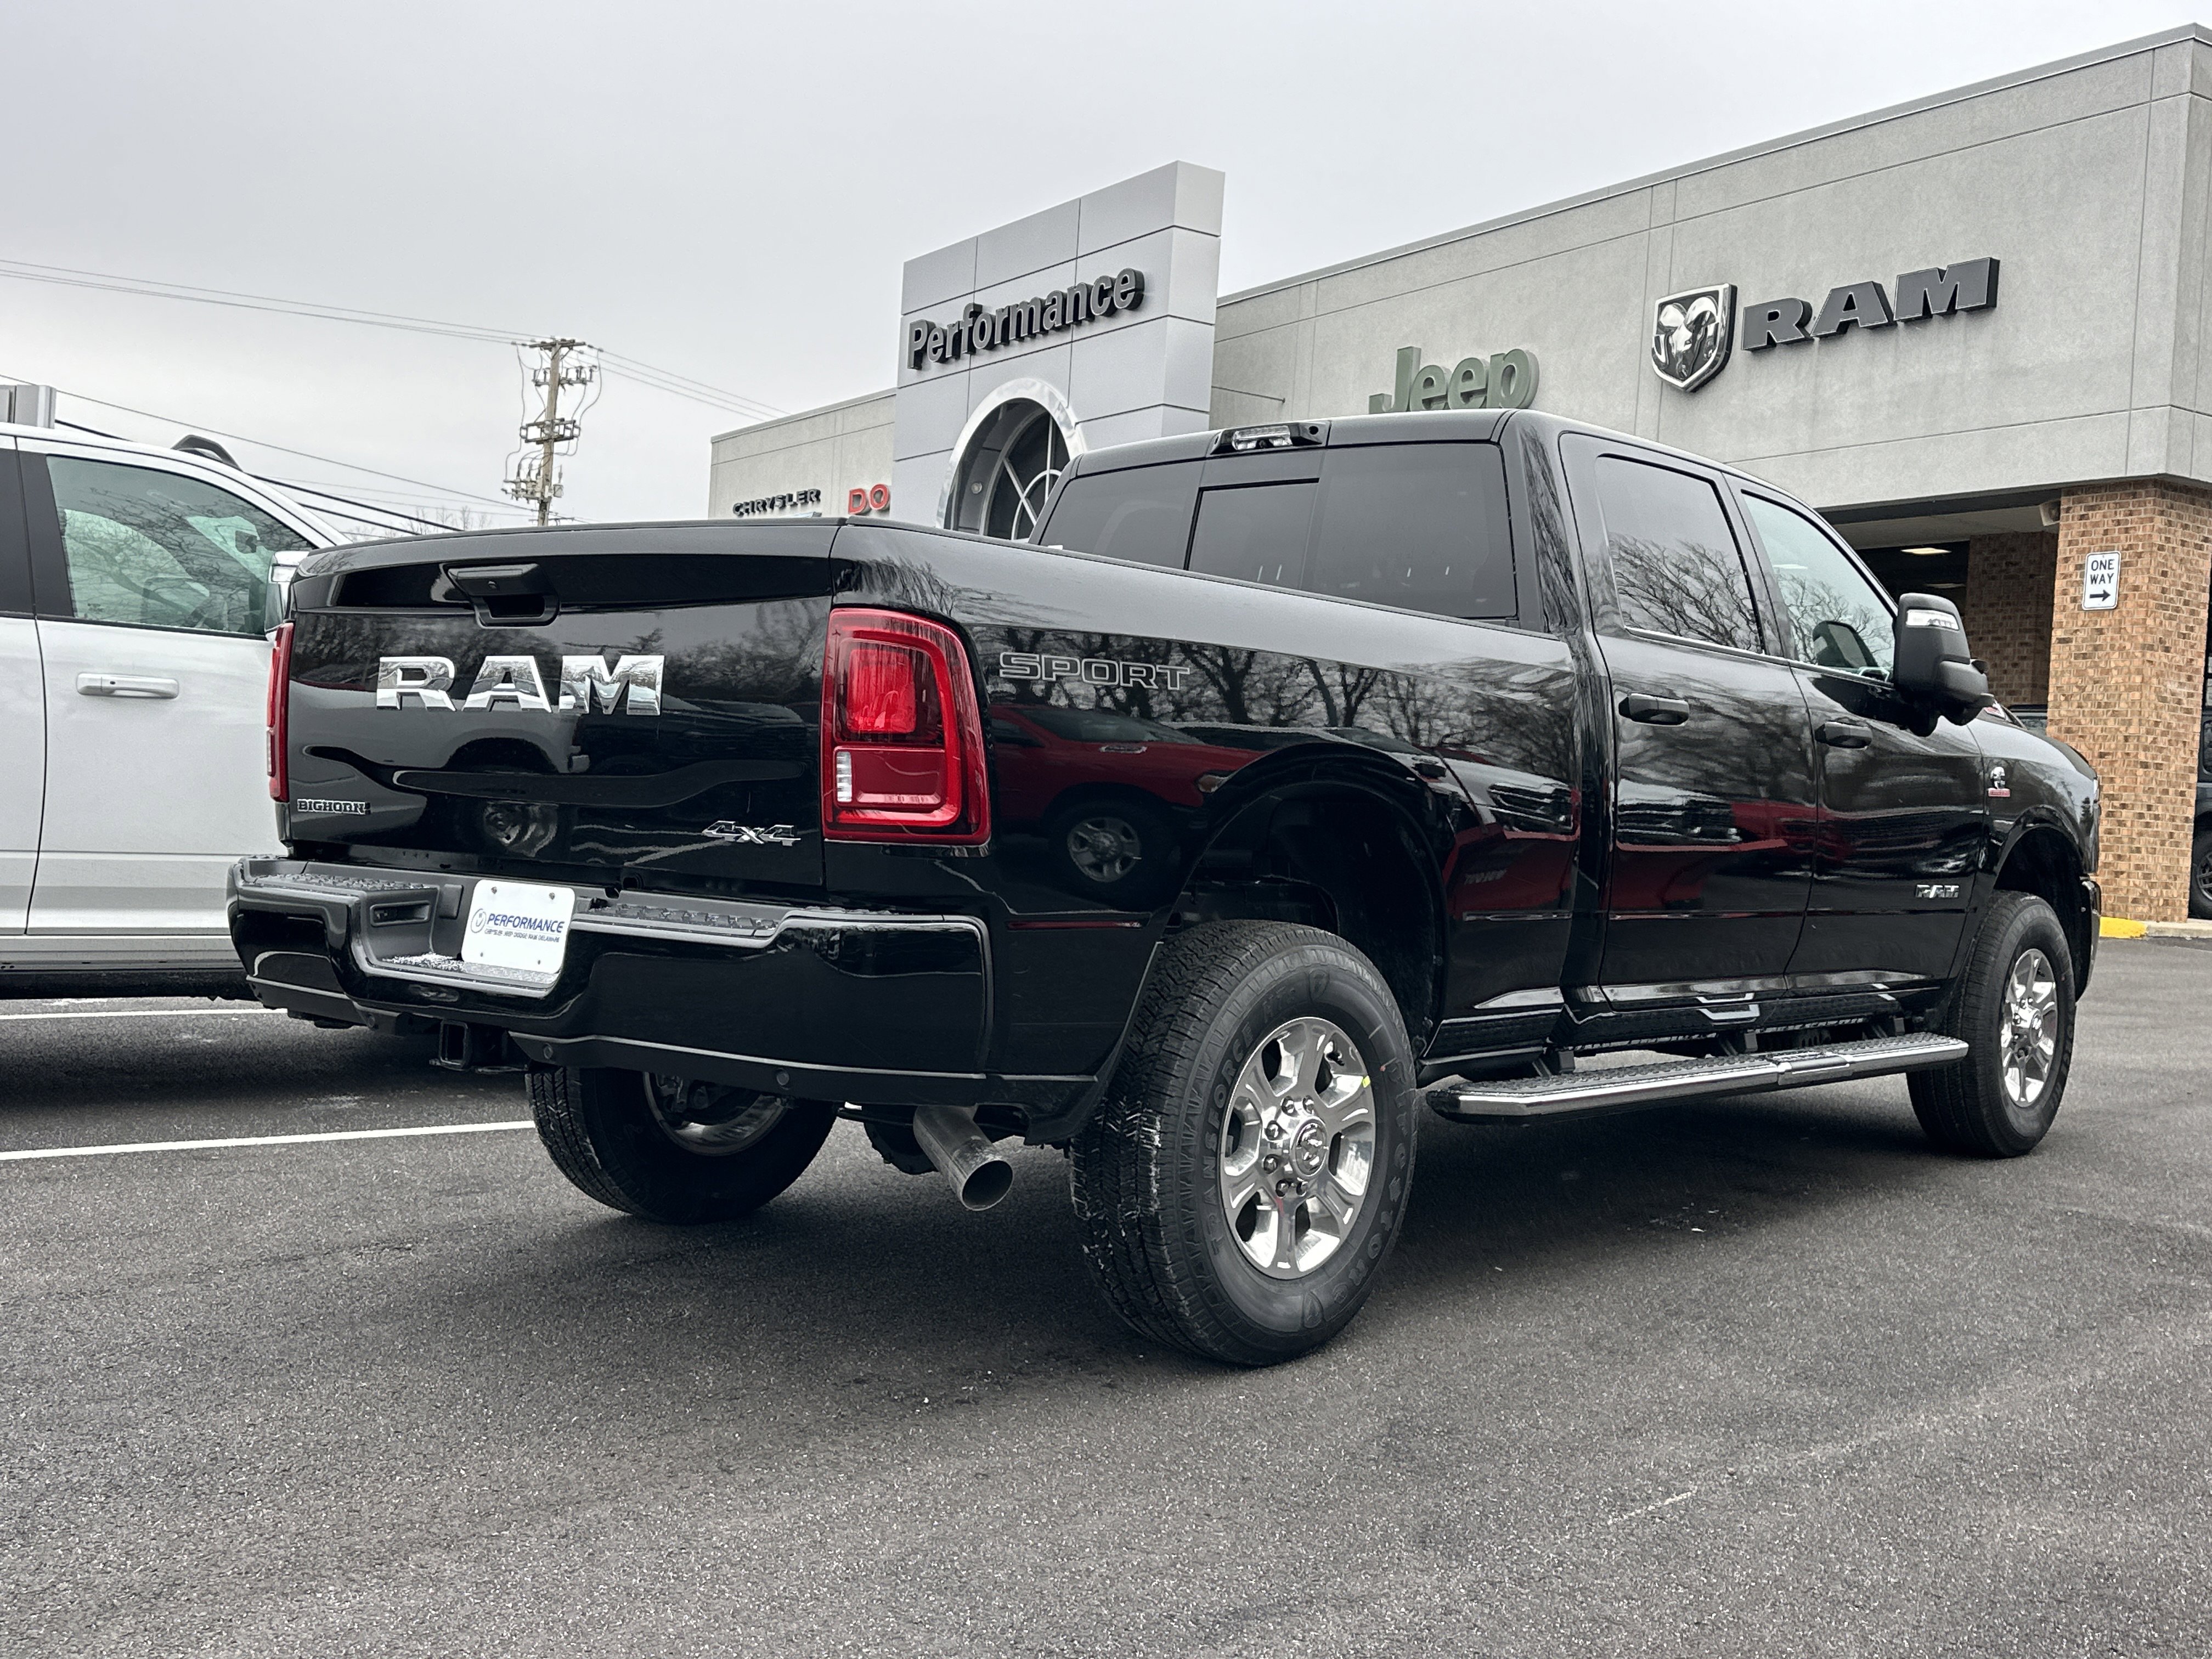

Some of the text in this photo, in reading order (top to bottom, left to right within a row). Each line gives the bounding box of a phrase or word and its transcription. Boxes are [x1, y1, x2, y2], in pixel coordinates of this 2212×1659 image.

[1741, 257, 2000, 351] RAM
[907, 268, 1145, 370] Performance
[1369, 346, 1540, 415] Jeep
[732, 488, 821, 517] CHRYSLER
[2090, 573, 2114, 585] WAY
[2091, 558, 2114, 571] ONE
[376, 655, 664, 715] RAM
[1000, 652, 1190, 690] SPORT
[297, 799, 367, 815] BIGHORN
[1915, 884, 1960, 899] RAM
[487, 913, 565, 933] PERFORMANCE
